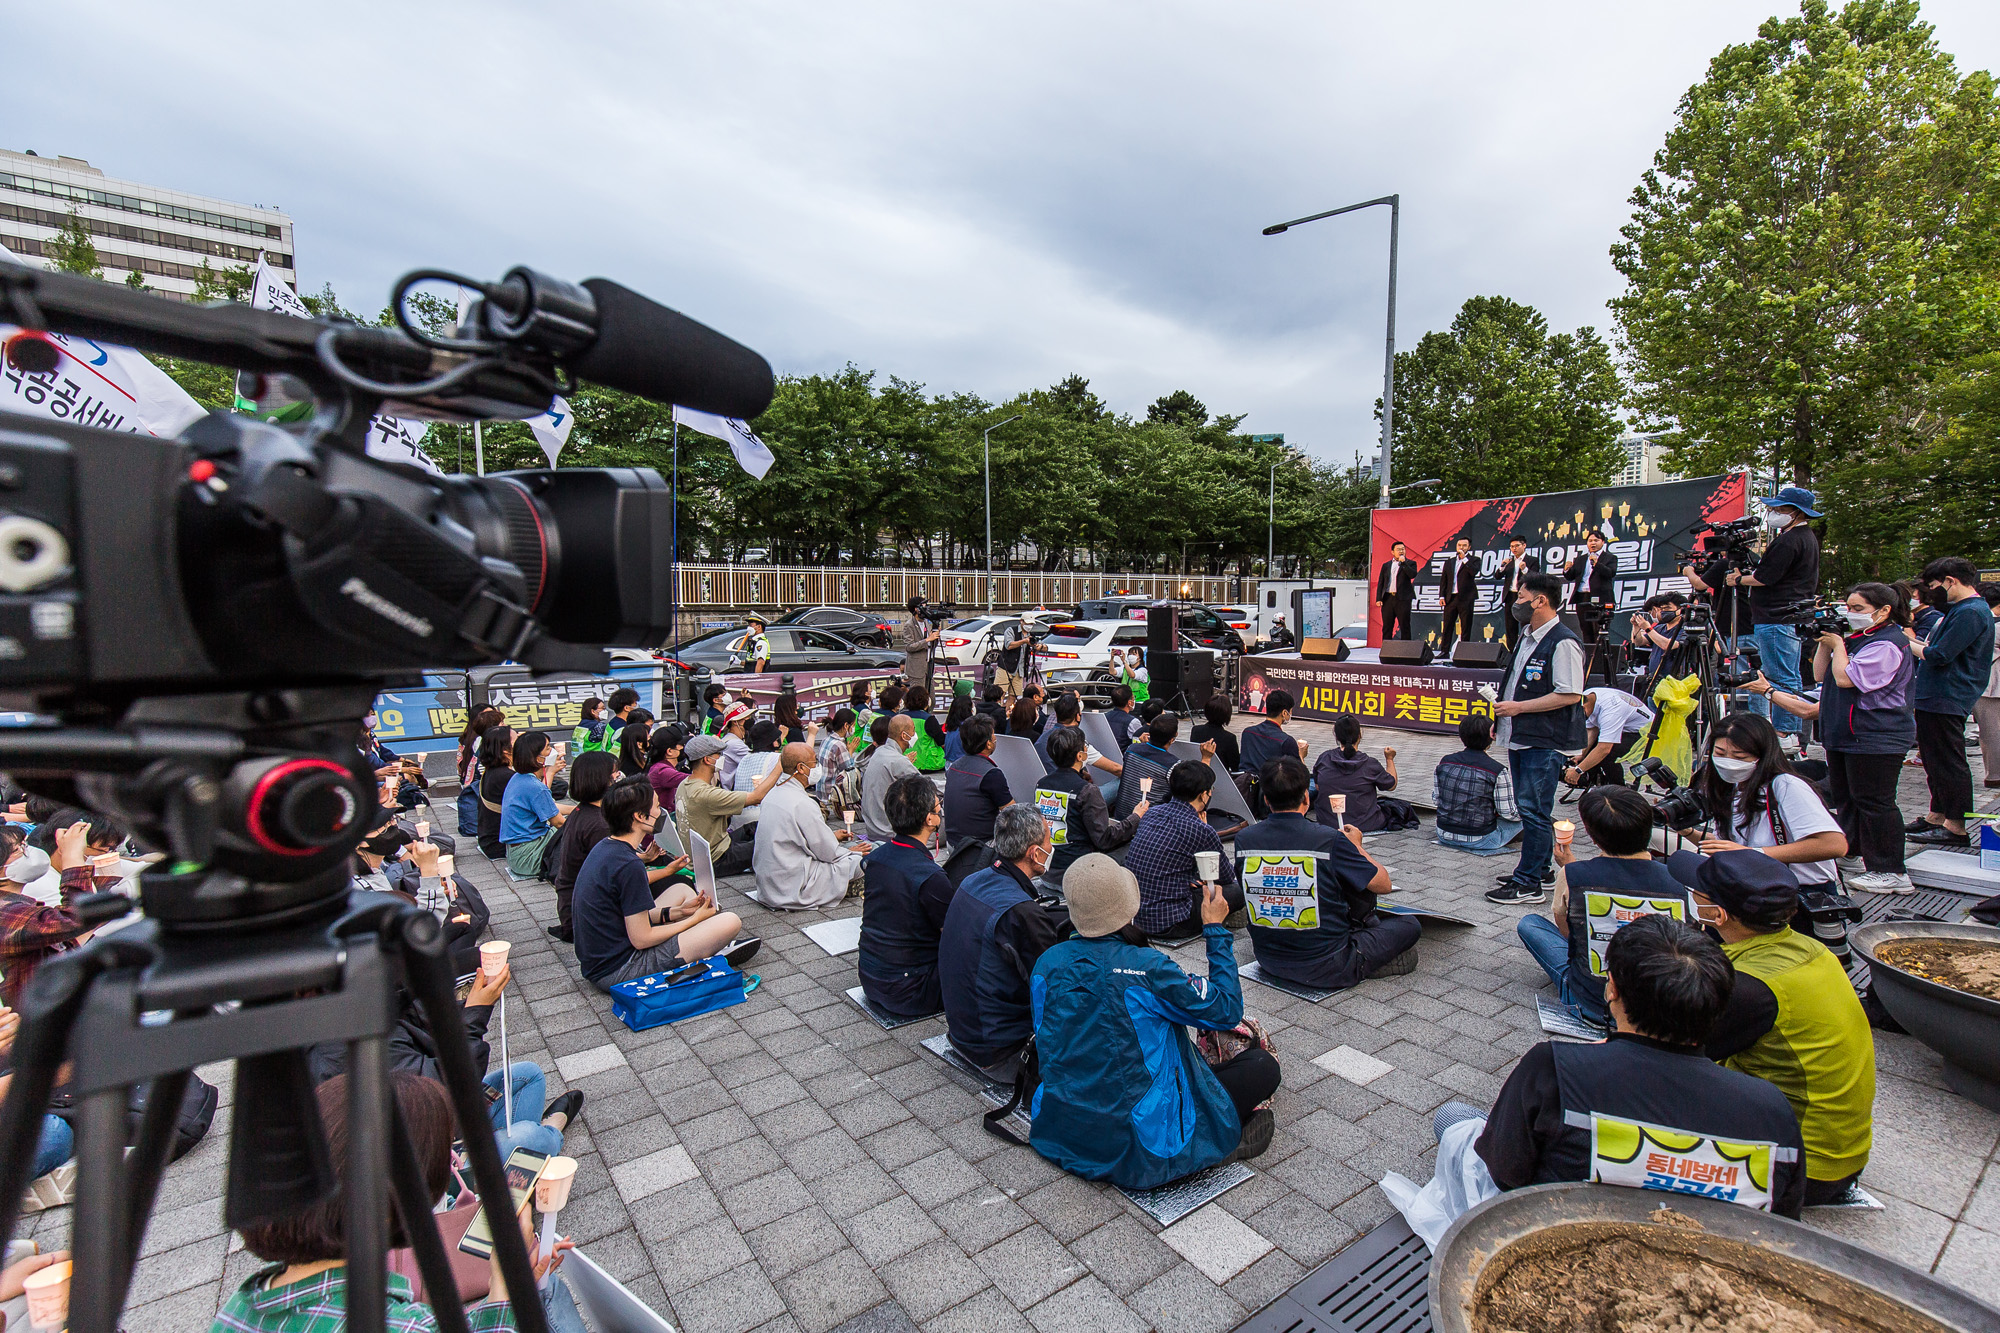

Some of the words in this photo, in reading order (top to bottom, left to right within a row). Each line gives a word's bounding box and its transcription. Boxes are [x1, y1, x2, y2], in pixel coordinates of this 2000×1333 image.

[340, 577, 434, 637] Panasonic
[1265, 667, 1296, 680] 국민안전
[1297, 670, 1314, 681] 위한
[1315, 671, 1369, 685] 화물안전운임
[1371, 674, 1390, 687] 전면
[1392, 675, 1435, 690] 확대촉구!
[1438, 679, 1449, 691] 새
[1452, 679, 1474, 692] 정부
[1299, 686, 1386, 717] 시민사회
[1262, 866, 1300, 876] 동네방네
[1262, 875, 1300, 888] 공공성
[1259, 895, 1294, 906] 구석구석
[1260, 904, 1295, 918] 노동권
[1645, 1152, 1739, 1187] 동네방네
